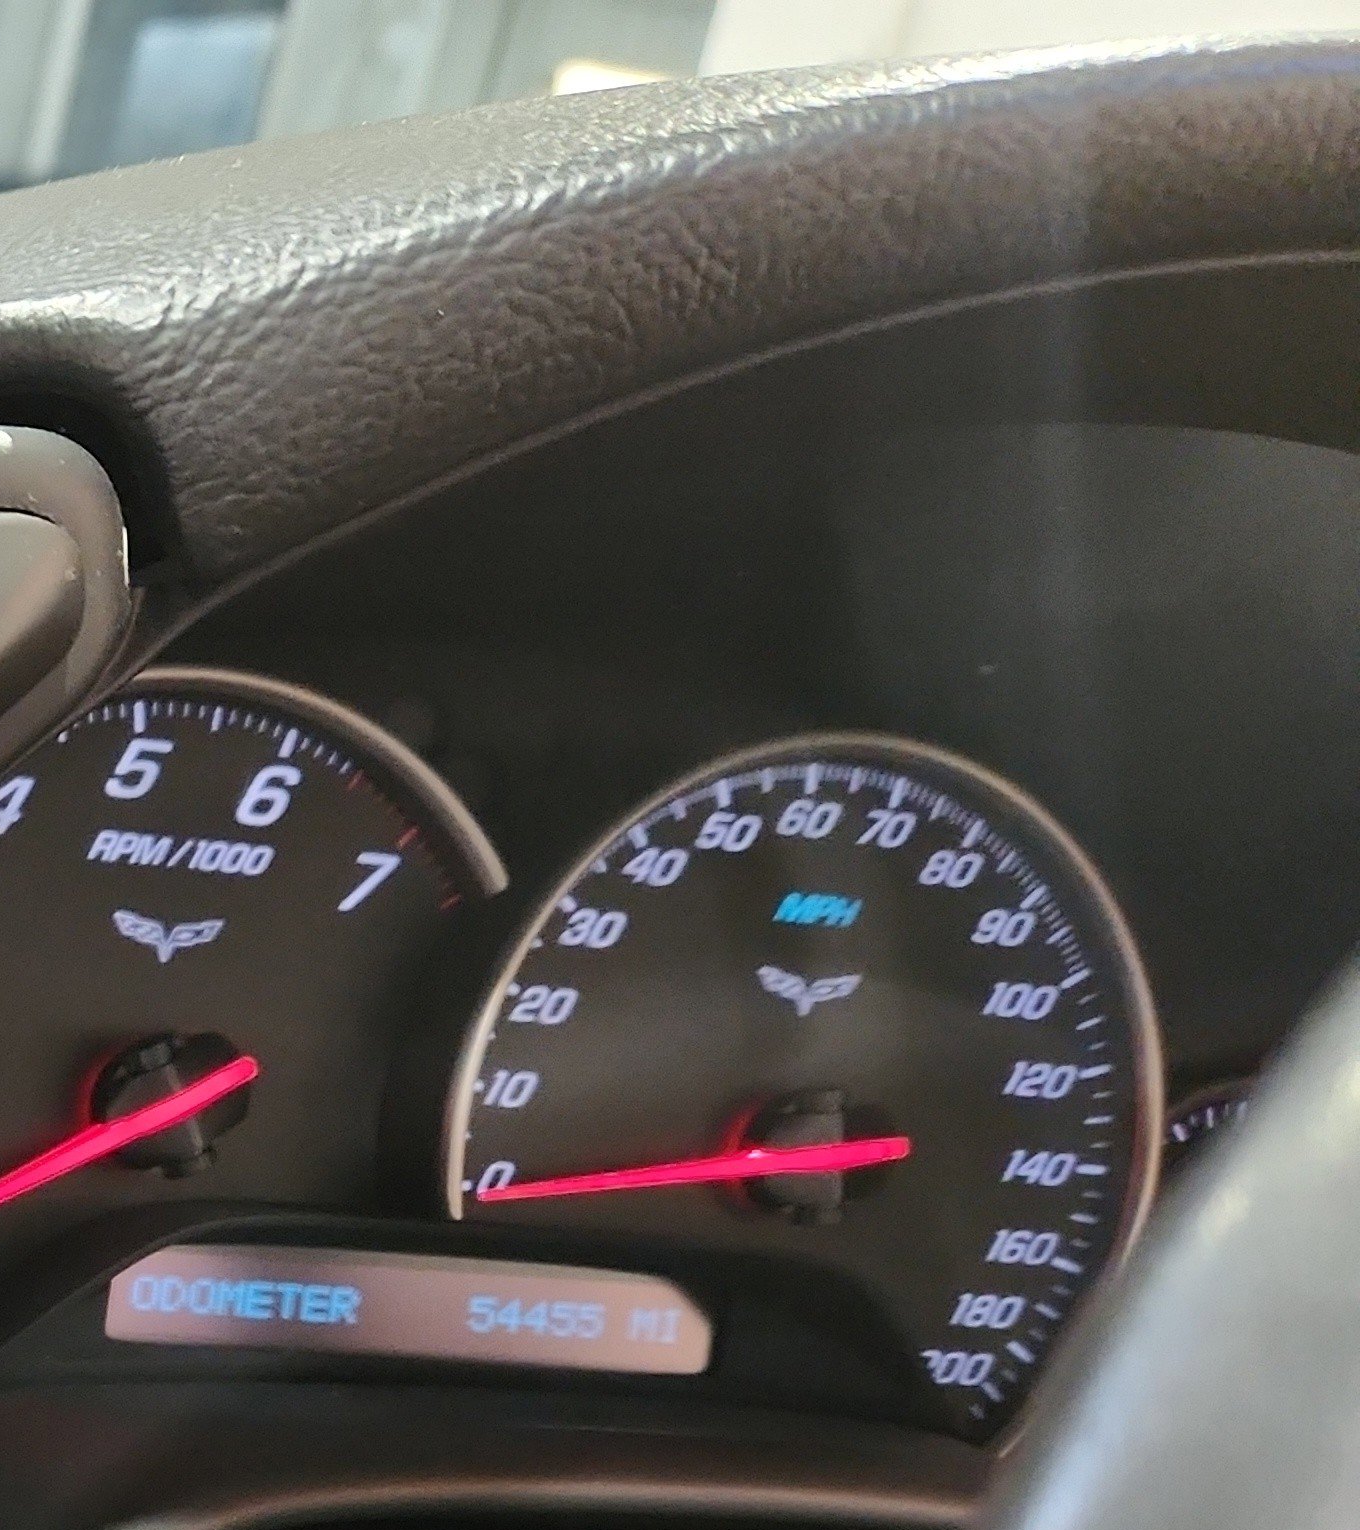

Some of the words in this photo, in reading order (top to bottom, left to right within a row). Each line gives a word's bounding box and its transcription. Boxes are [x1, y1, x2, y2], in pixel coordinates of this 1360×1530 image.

[104, 737, 173, 799] 5
[235, 765, 301, 827] 6
[694, 811, 763, 852] 50
[776, 798, 842, 839] 60
[857, 810, 917, 849] 70
[337, 851, 401, 912] 7
[622, 847, 689, 887] 40
[918, 850, 984, 888] 80
[558, 907, 627, 949] 30
[773, 892, 862, 928] MPH
[971, 908, 1037, 947] 90
[507, 984, 579, 1025] 20
[982, 981, 1059, 1020] 100
[483, 1070, 539, 1109] 10
[1003, 1061, 1075, 1099] 120
[1002, 1149, 1072, 1187] 140
[985, 1229, 1054, 1266] 160
[130, 1274, 362, 1325] ODOMETER
[467, 1292, 606, 1341] 54455
[625, 1306, 683, 1346] MI
[950, 1293, 1025, 1329] 180
